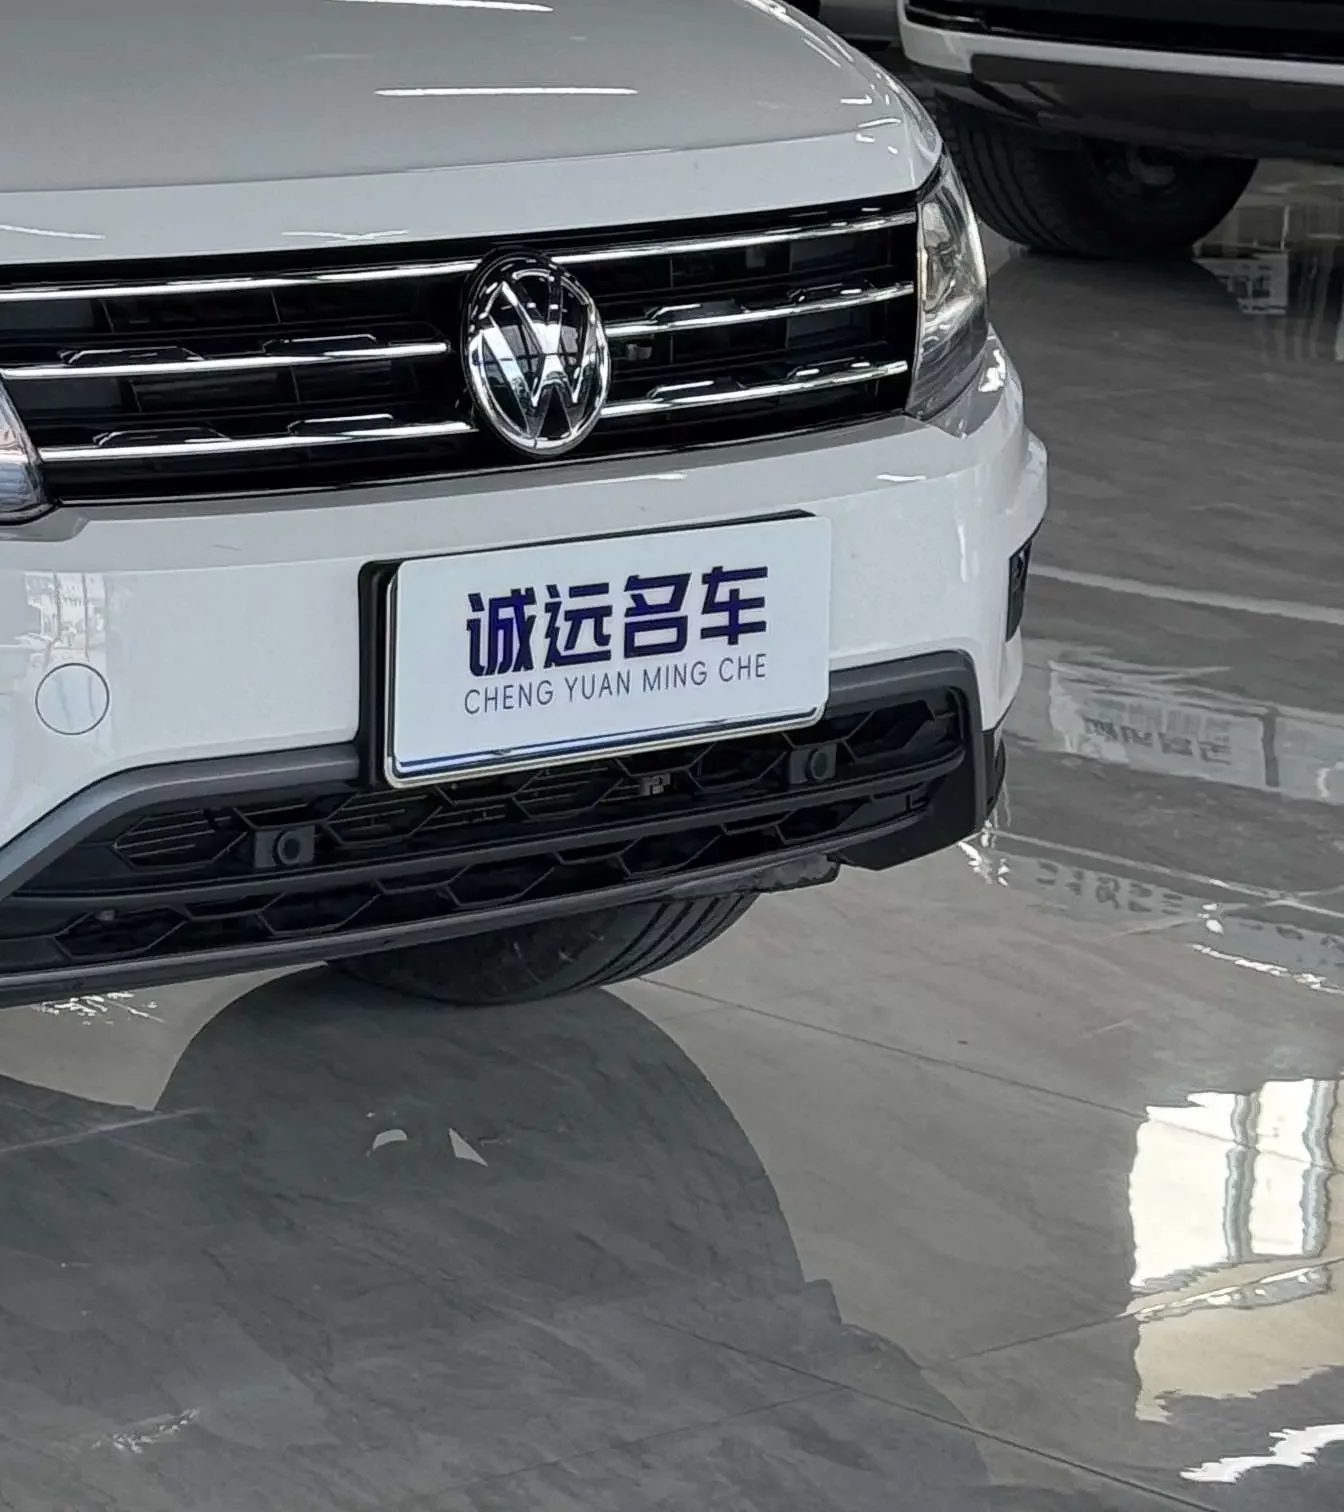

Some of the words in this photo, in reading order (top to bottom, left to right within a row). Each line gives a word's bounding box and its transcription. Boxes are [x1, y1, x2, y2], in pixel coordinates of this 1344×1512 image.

[466, 565, 769, 678] 诚远名车
[464, 679, 554, 716] CHENG
[564, 669, 633, 704] YUAN
[642, 660, 709, 693] MING
[717, 653, 768, 683] CHE
